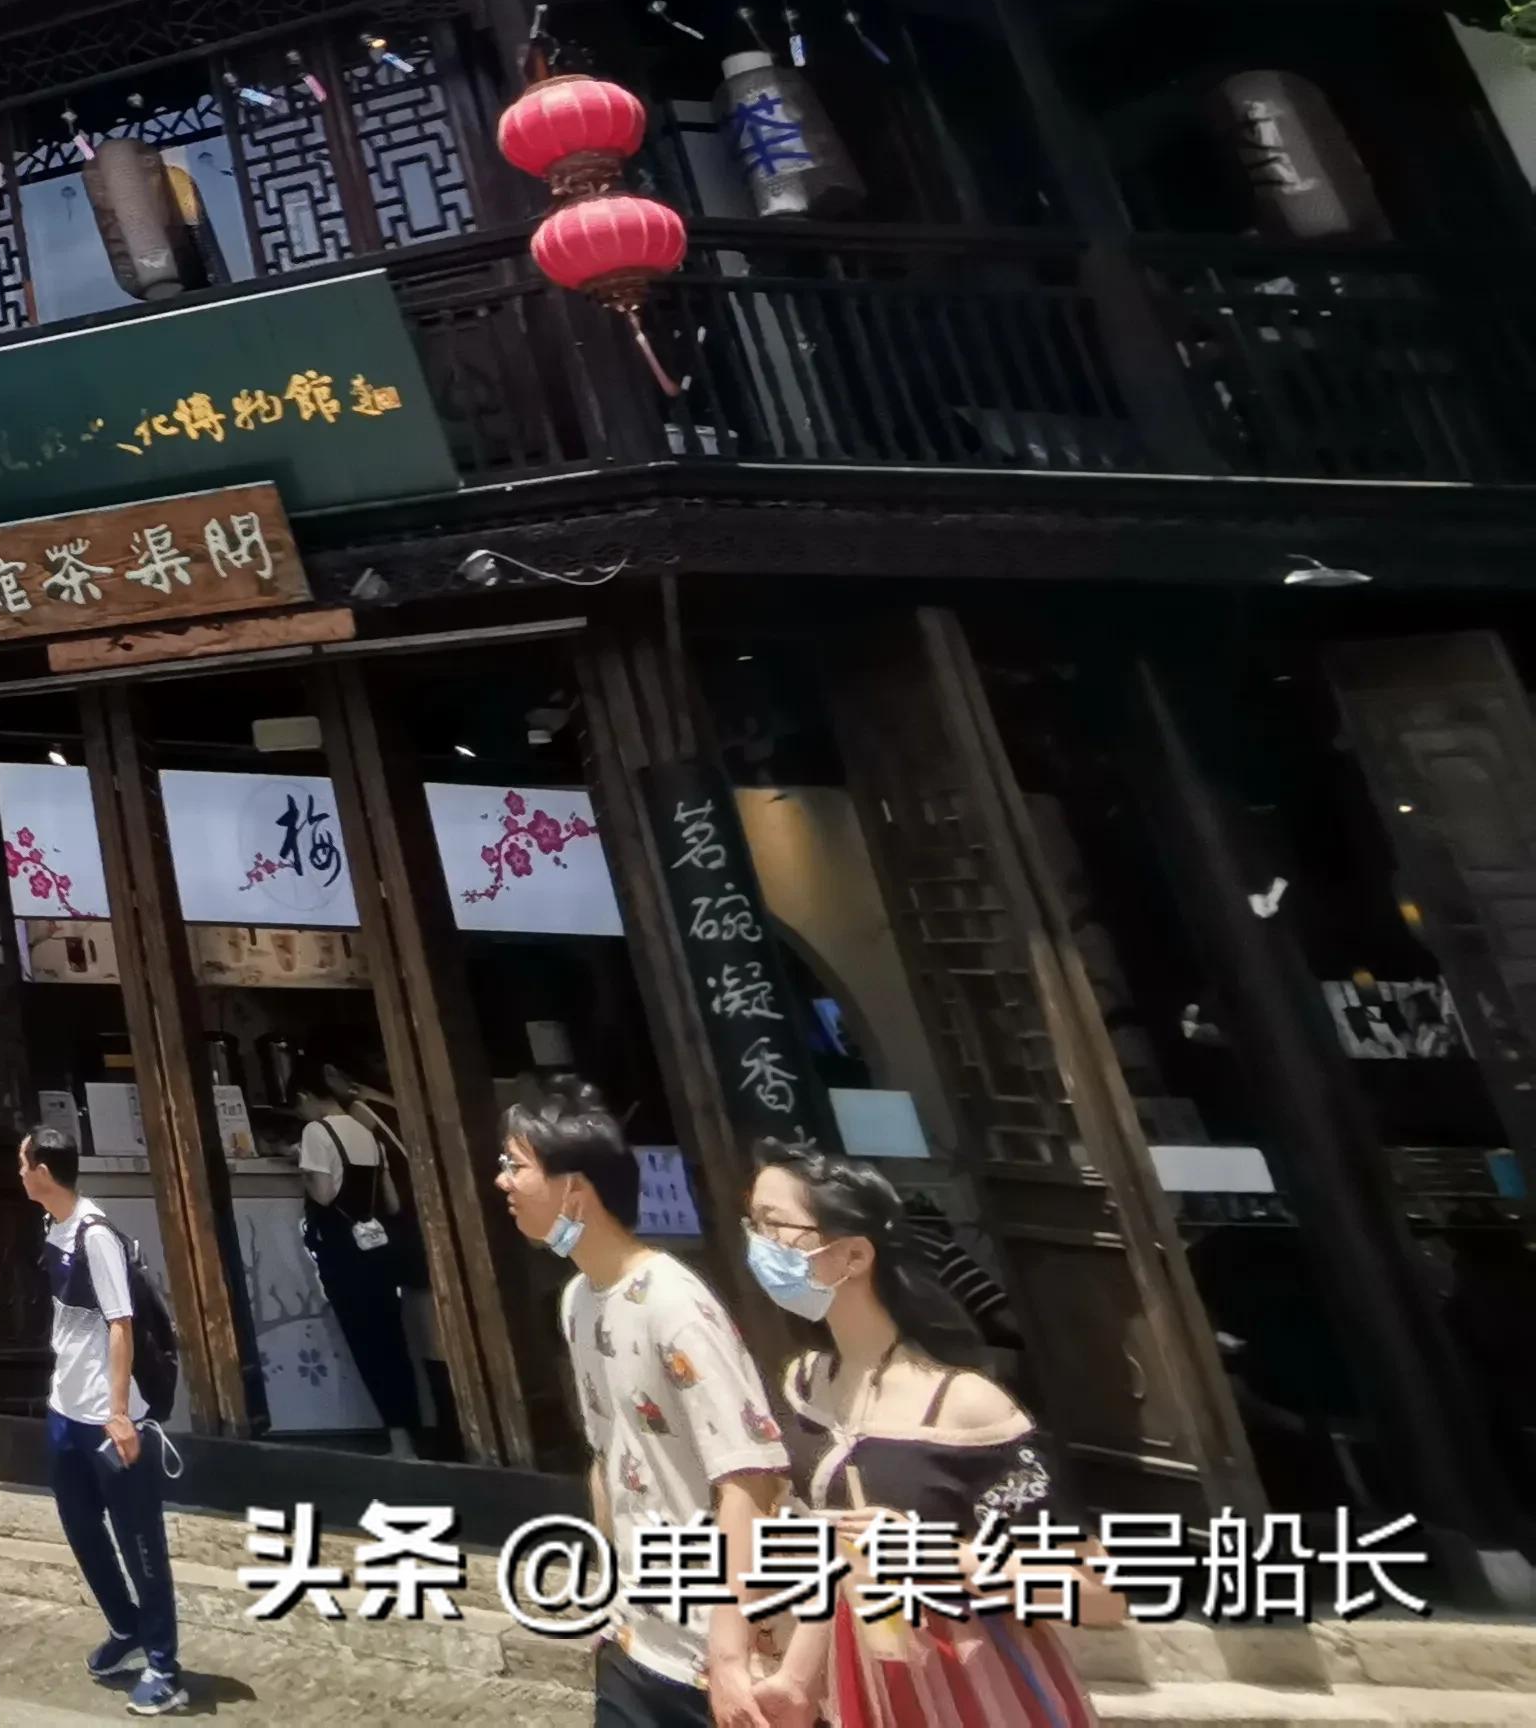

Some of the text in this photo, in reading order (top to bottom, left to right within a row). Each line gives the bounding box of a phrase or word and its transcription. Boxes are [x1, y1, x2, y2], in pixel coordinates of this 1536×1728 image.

[275, 792, 343, 889] 梅
[670, 798, 814, 1138] 茗碗凝香
